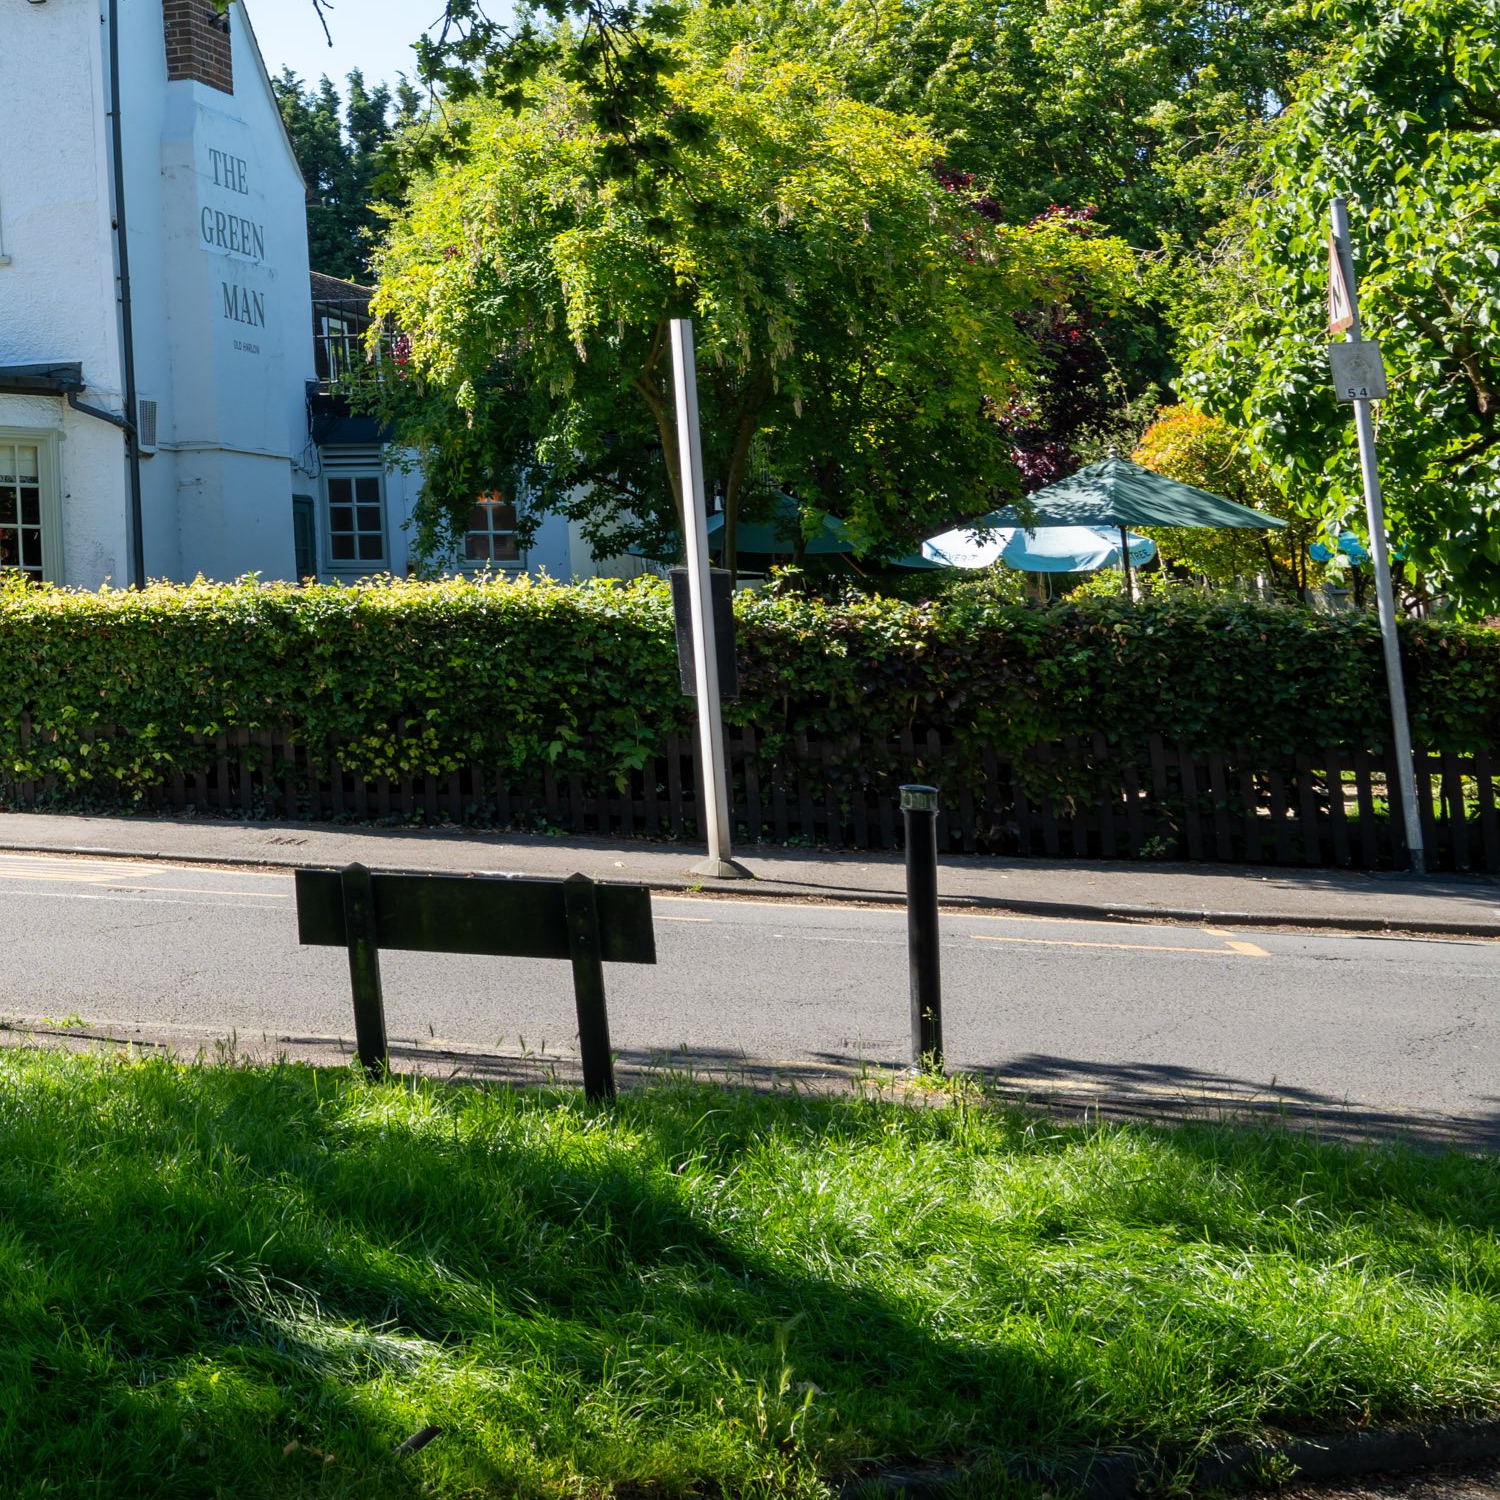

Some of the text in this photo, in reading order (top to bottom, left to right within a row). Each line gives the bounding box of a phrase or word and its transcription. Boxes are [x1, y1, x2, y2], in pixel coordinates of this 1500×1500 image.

[209, 148, 249, 195] THE
[201, 206, 265, 260] GREEN
[222, 282, 265, 329] MAN
